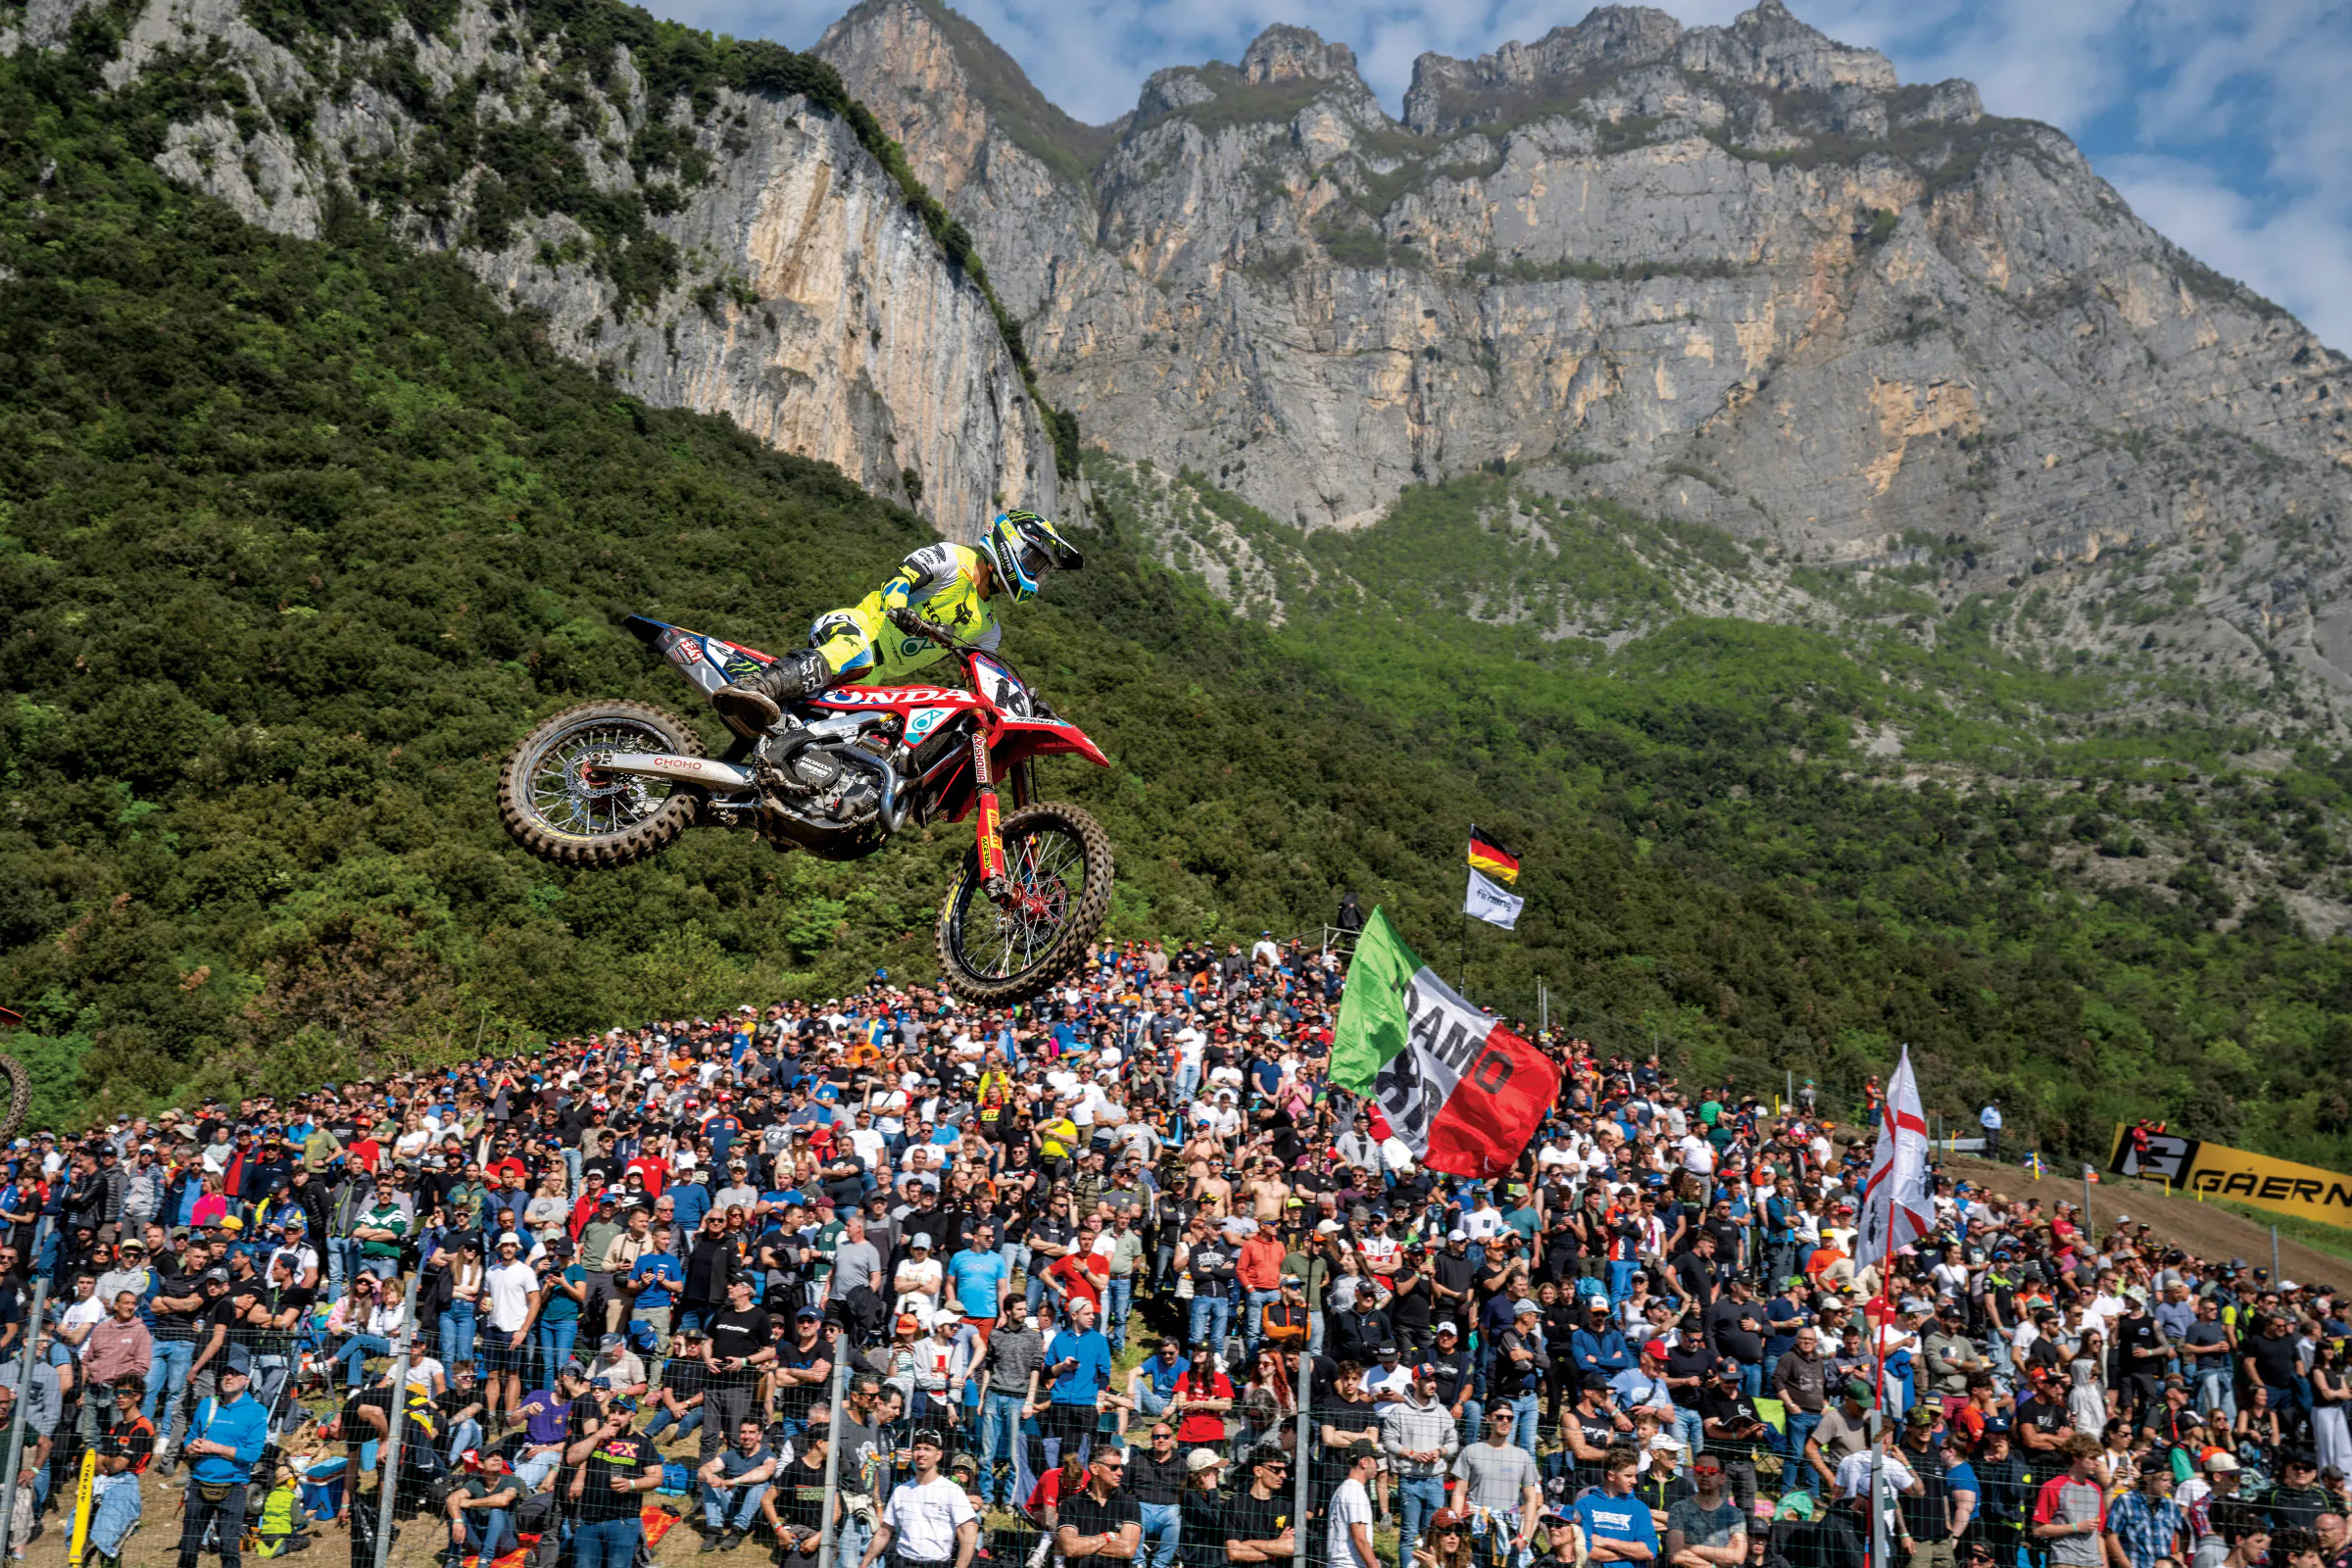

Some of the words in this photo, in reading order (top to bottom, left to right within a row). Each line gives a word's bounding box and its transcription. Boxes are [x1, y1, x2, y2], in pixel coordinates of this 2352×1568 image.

[1002, 521, 1012, 535] FOX
[824, 689, 977, 705] ONDA
[654, 758, 702, 770] CHOHO
[802, 756, 833, 772] HONDA
[974, 747, 986, 782] SHOWA
[981, 837, 991, 868] ACERBIS
[80, 1463, 92, 1503] ACERBIS
